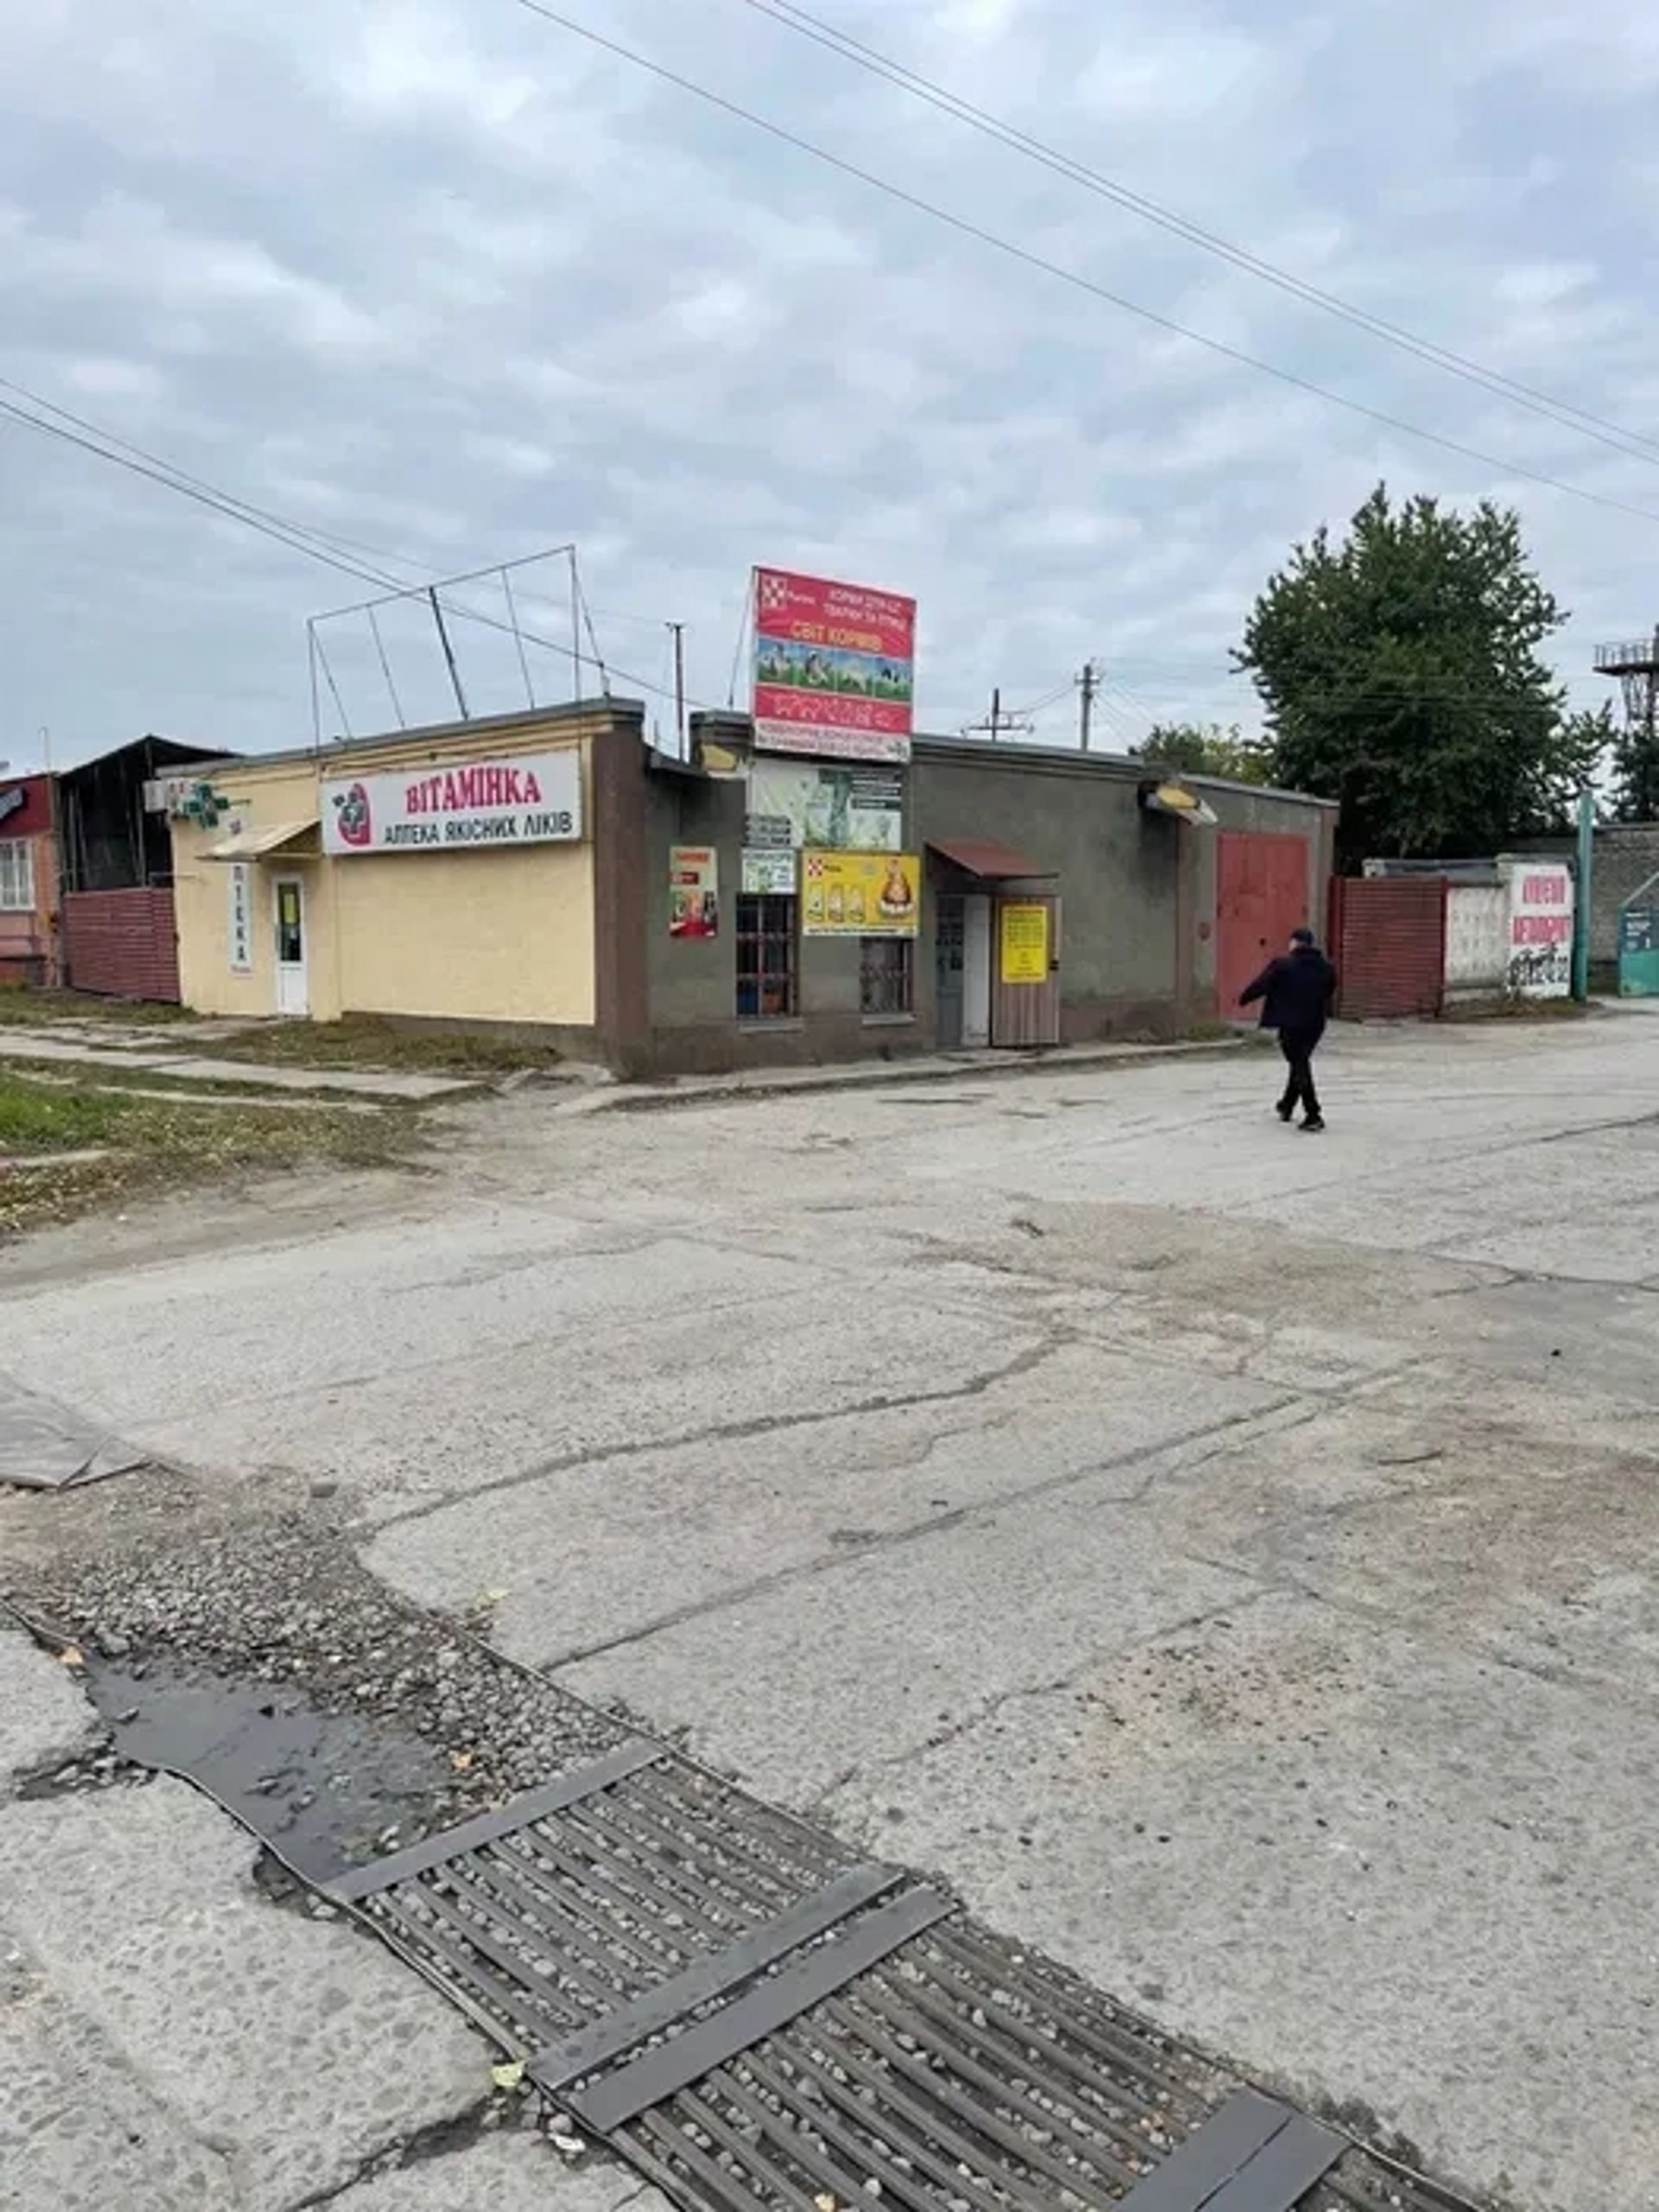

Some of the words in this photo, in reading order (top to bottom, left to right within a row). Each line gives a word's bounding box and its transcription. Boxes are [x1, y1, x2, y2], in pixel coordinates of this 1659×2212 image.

[791, 620, 825, 641] СВІТ
[406, 766, 542, 814] ВІТАМІНКА
[385, 823, 440, 844] АПТЕКА
[445, 815, 518, 842] ЯКІСНИХ
[524, 811, 573, 836] ЛІКІВ
